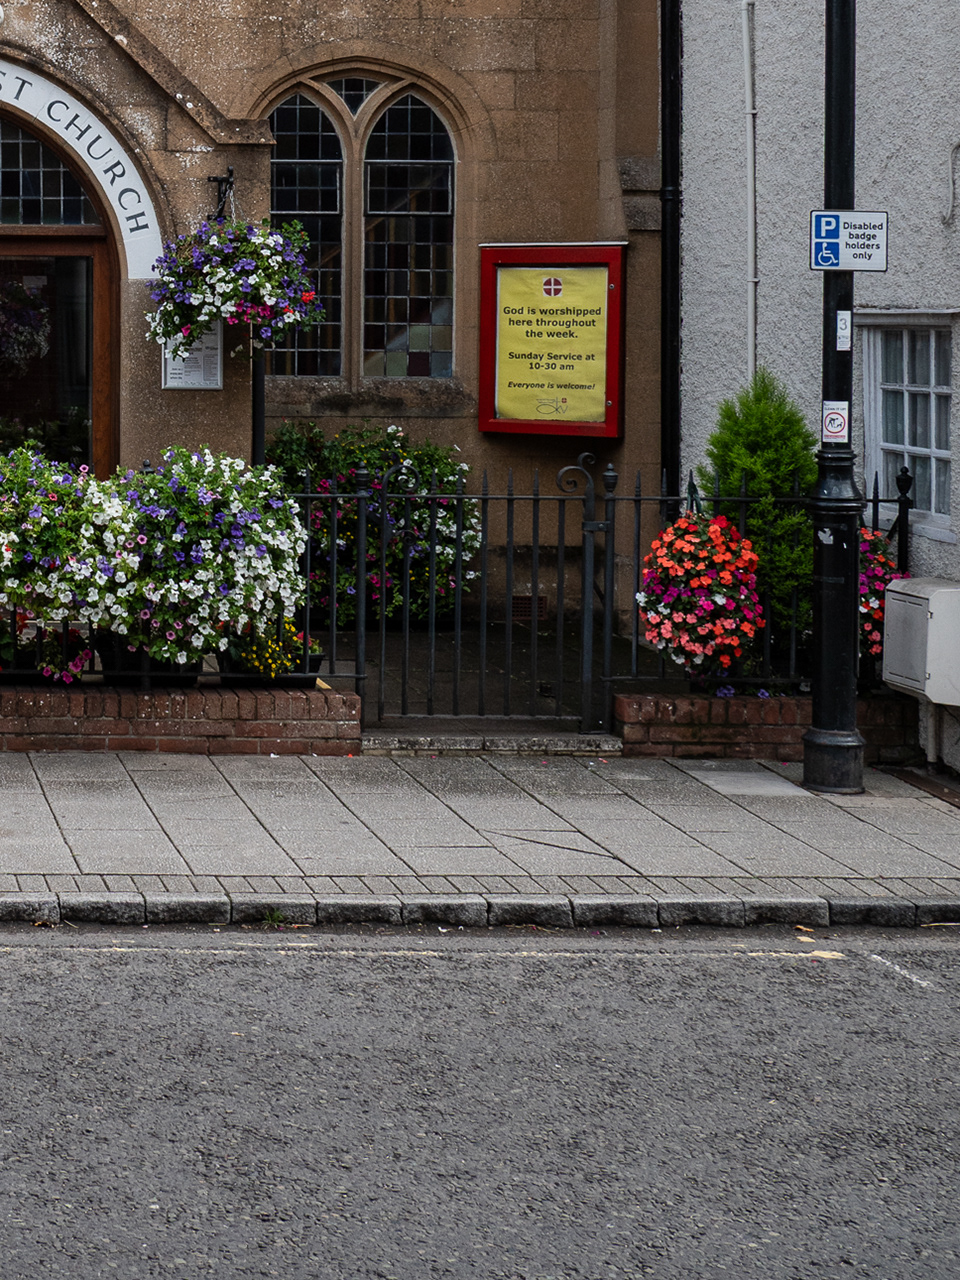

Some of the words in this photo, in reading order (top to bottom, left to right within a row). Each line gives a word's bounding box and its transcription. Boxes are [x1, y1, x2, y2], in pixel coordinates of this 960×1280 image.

[46, 99, 150, 234] CHURCH
[821, 217, 837, 237] P
[843, 222, 883, 230] Disabled
[848, 232, 877, 241] badge
[845, 241, 881, 250] holders
[852, 251, 873, 261] only
[503, 306, 524, 315] God
[527, 306, 537, 315] is
[539, 306, 602, 318] worshipped
[508, 317, 533, 327] here
[535, 318, 597, 329] throughout
[839, 318, 848, 331] 3
[525, 329, 544, 338] the
[546, 329, 578, 339] week.
[508, 351, 544, 361] Sunday
[547, 352, 582, 361] Service
[585, 353, 596, 361] at
[529, 362, 557, 370] 10-30
[559, 363, 575, 371] am
[507, 382, 546, 390] Everyone
[547, 381, 555, 389] is
[556, 382, 596, 390] welcome!
